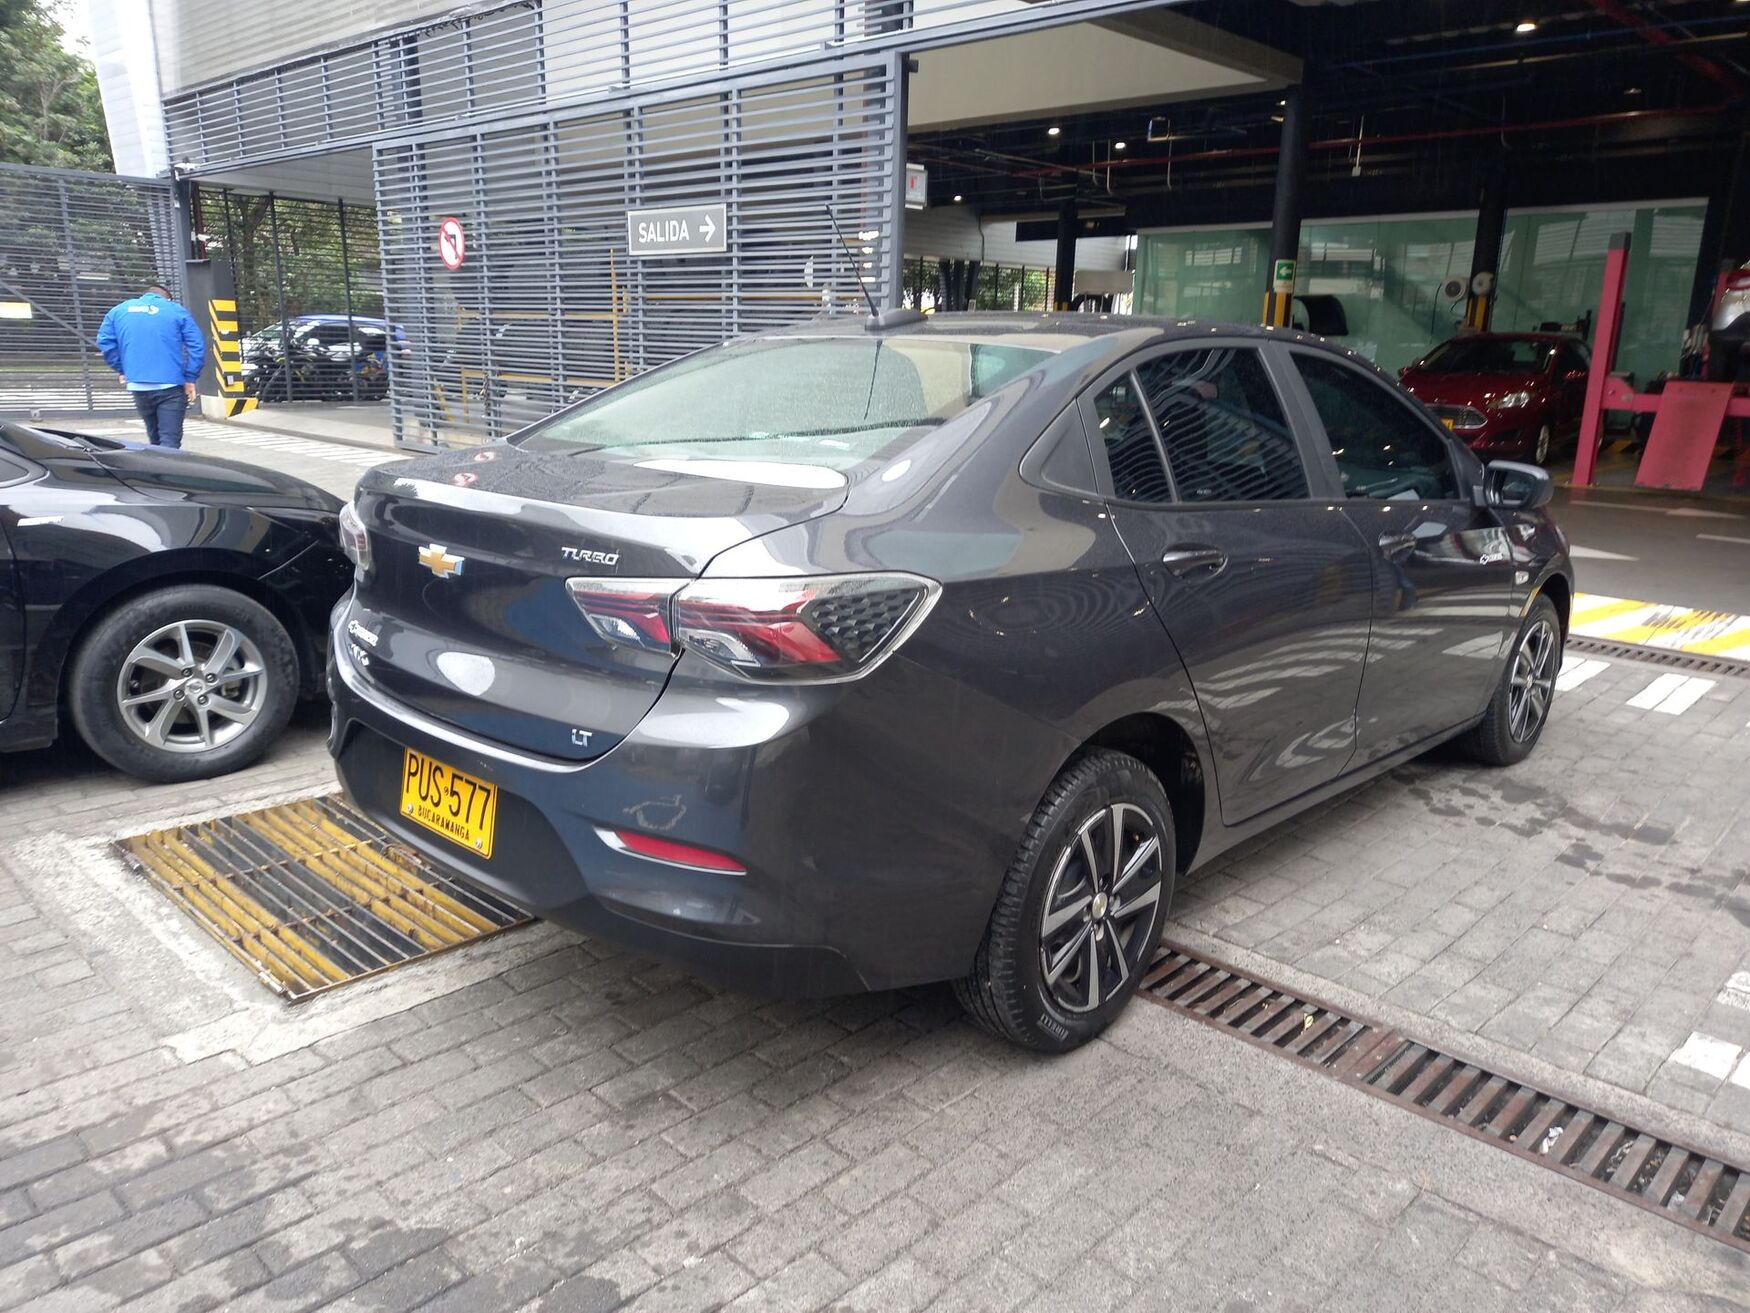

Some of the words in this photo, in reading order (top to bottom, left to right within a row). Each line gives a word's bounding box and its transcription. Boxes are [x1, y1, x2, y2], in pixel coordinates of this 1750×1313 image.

[638, 219, 690, 243] SALIDA
[561, 546, 619, 565] TURBO
[571, 728, 593, 748] LT
[417, 804, 470, 840] BUCARAMANGA
